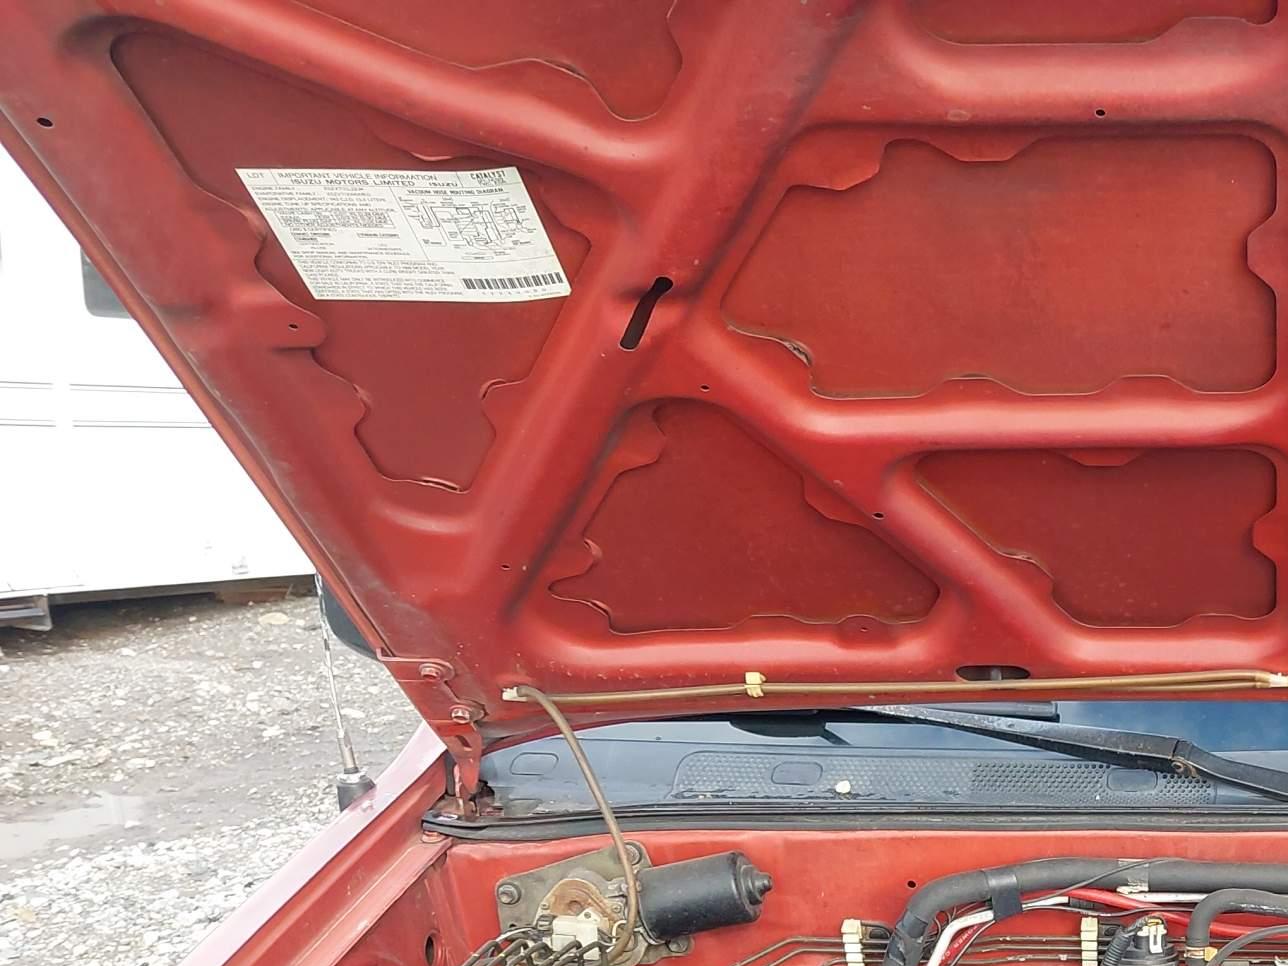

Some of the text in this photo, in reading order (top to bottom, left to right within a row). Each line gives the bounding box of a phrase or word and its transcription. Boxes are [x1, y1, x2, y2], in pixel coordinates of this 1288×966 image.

[374, 173, 438, 181] INFORMATION
[470, 170, 506, 180] CATALYST
[372, 179, 415, 187] LIMITED
